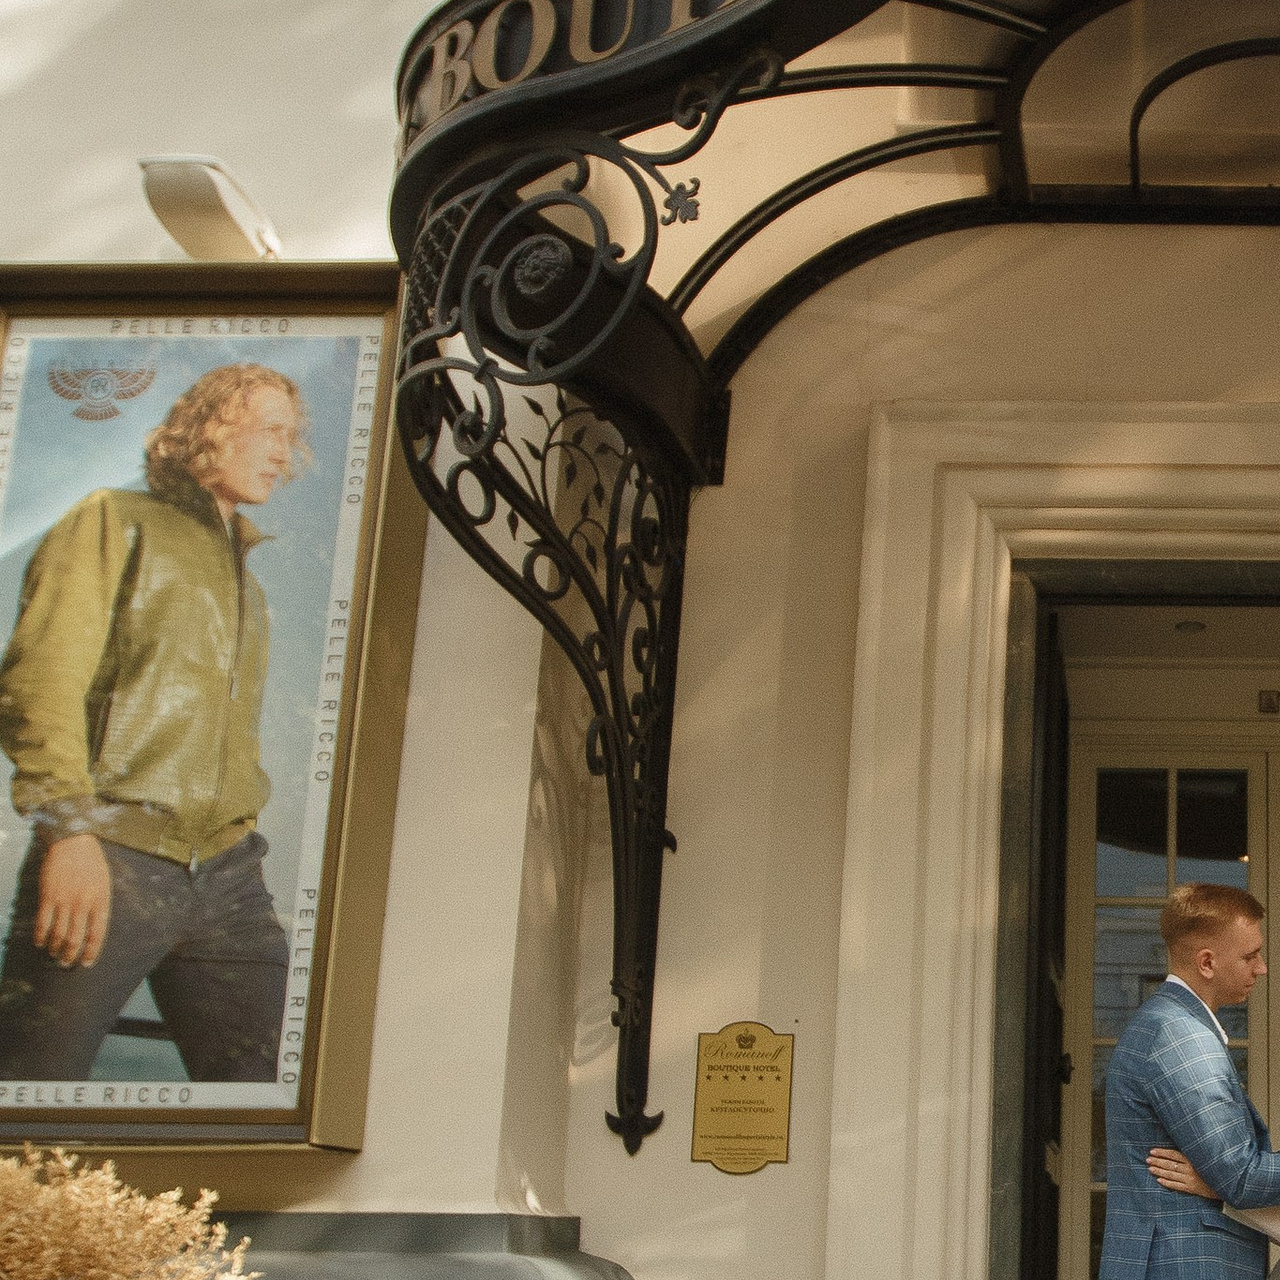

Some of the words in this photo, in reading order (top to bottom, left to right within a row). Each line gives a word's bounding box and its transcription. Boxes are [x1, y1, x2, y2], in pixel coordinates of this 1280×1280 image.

[110, 318, 194, 335] PELLE
[208, 317, 291, 335] RICCO
[357, 334, 381, 413] PELLE
[346, 427, 370, 505] RICCO
[323, 599, 349, 683] PELLE
[313, 698, 339, 782] RICCO
[292, 888, 317, 977] PELLE
[282, 996, 306, 1085] RICCO
[704, 1040, 787, 1061] Romanoff
[707, 1064, 751, 1073] BOUTIQUE
[752, 1065, 781, 1073] HOTEL
[102, 1086, 192, 1104] RICCO
